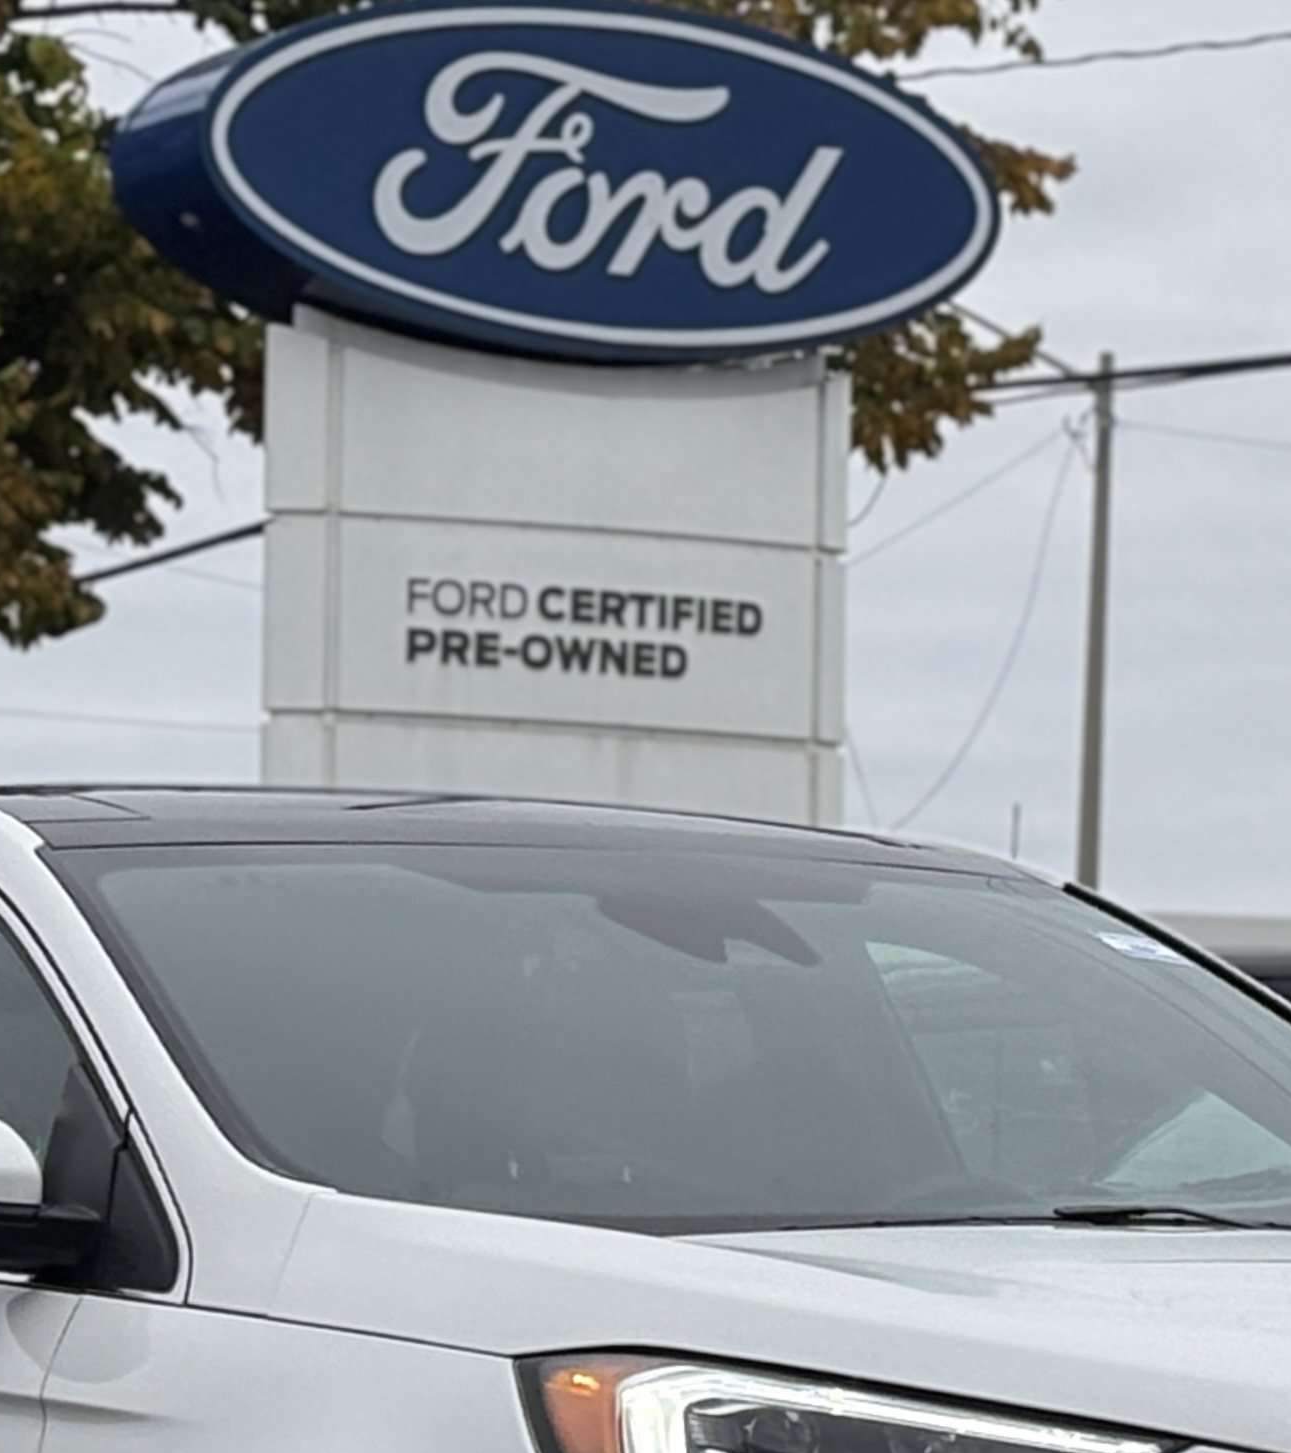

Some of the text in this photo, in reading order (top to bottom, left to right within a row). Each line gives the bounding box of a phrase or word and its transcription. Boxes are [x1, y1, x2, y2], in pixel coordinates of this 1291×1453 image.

[373, 50, 845, 293] Ford
[407, 578, 763, 636] FORD CERTIFIED
[406, 628, 689, 678] PRE-OWNED
